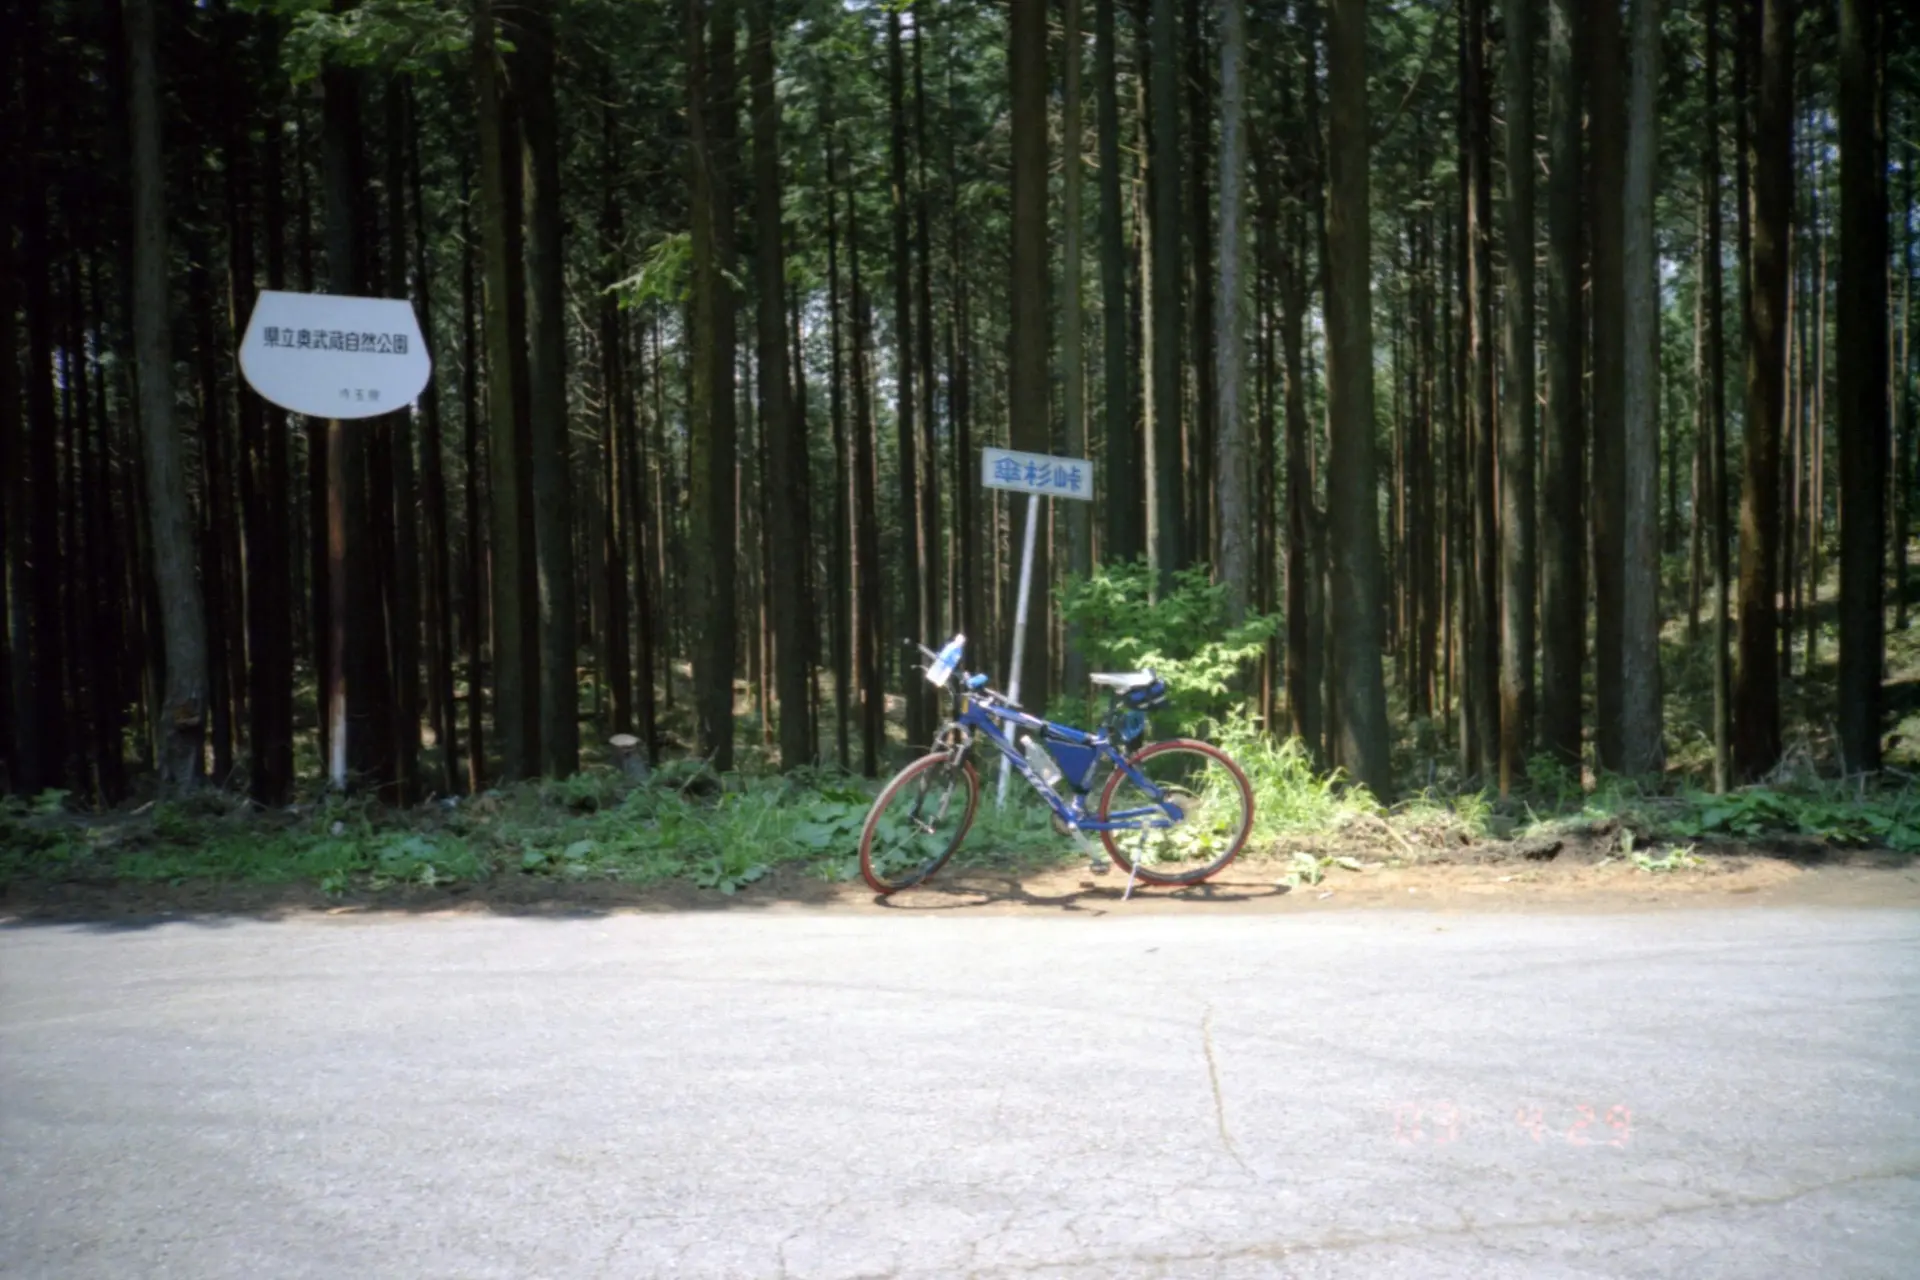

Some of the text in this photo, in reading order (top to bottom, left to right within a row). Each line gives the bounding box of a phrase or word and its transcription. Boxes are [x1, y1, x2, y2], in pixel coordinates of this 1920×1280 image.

[264, 326, 408, 354] 県立奥武蔵自然公園
[993, 457, 1082, 492] 傘杉峠
